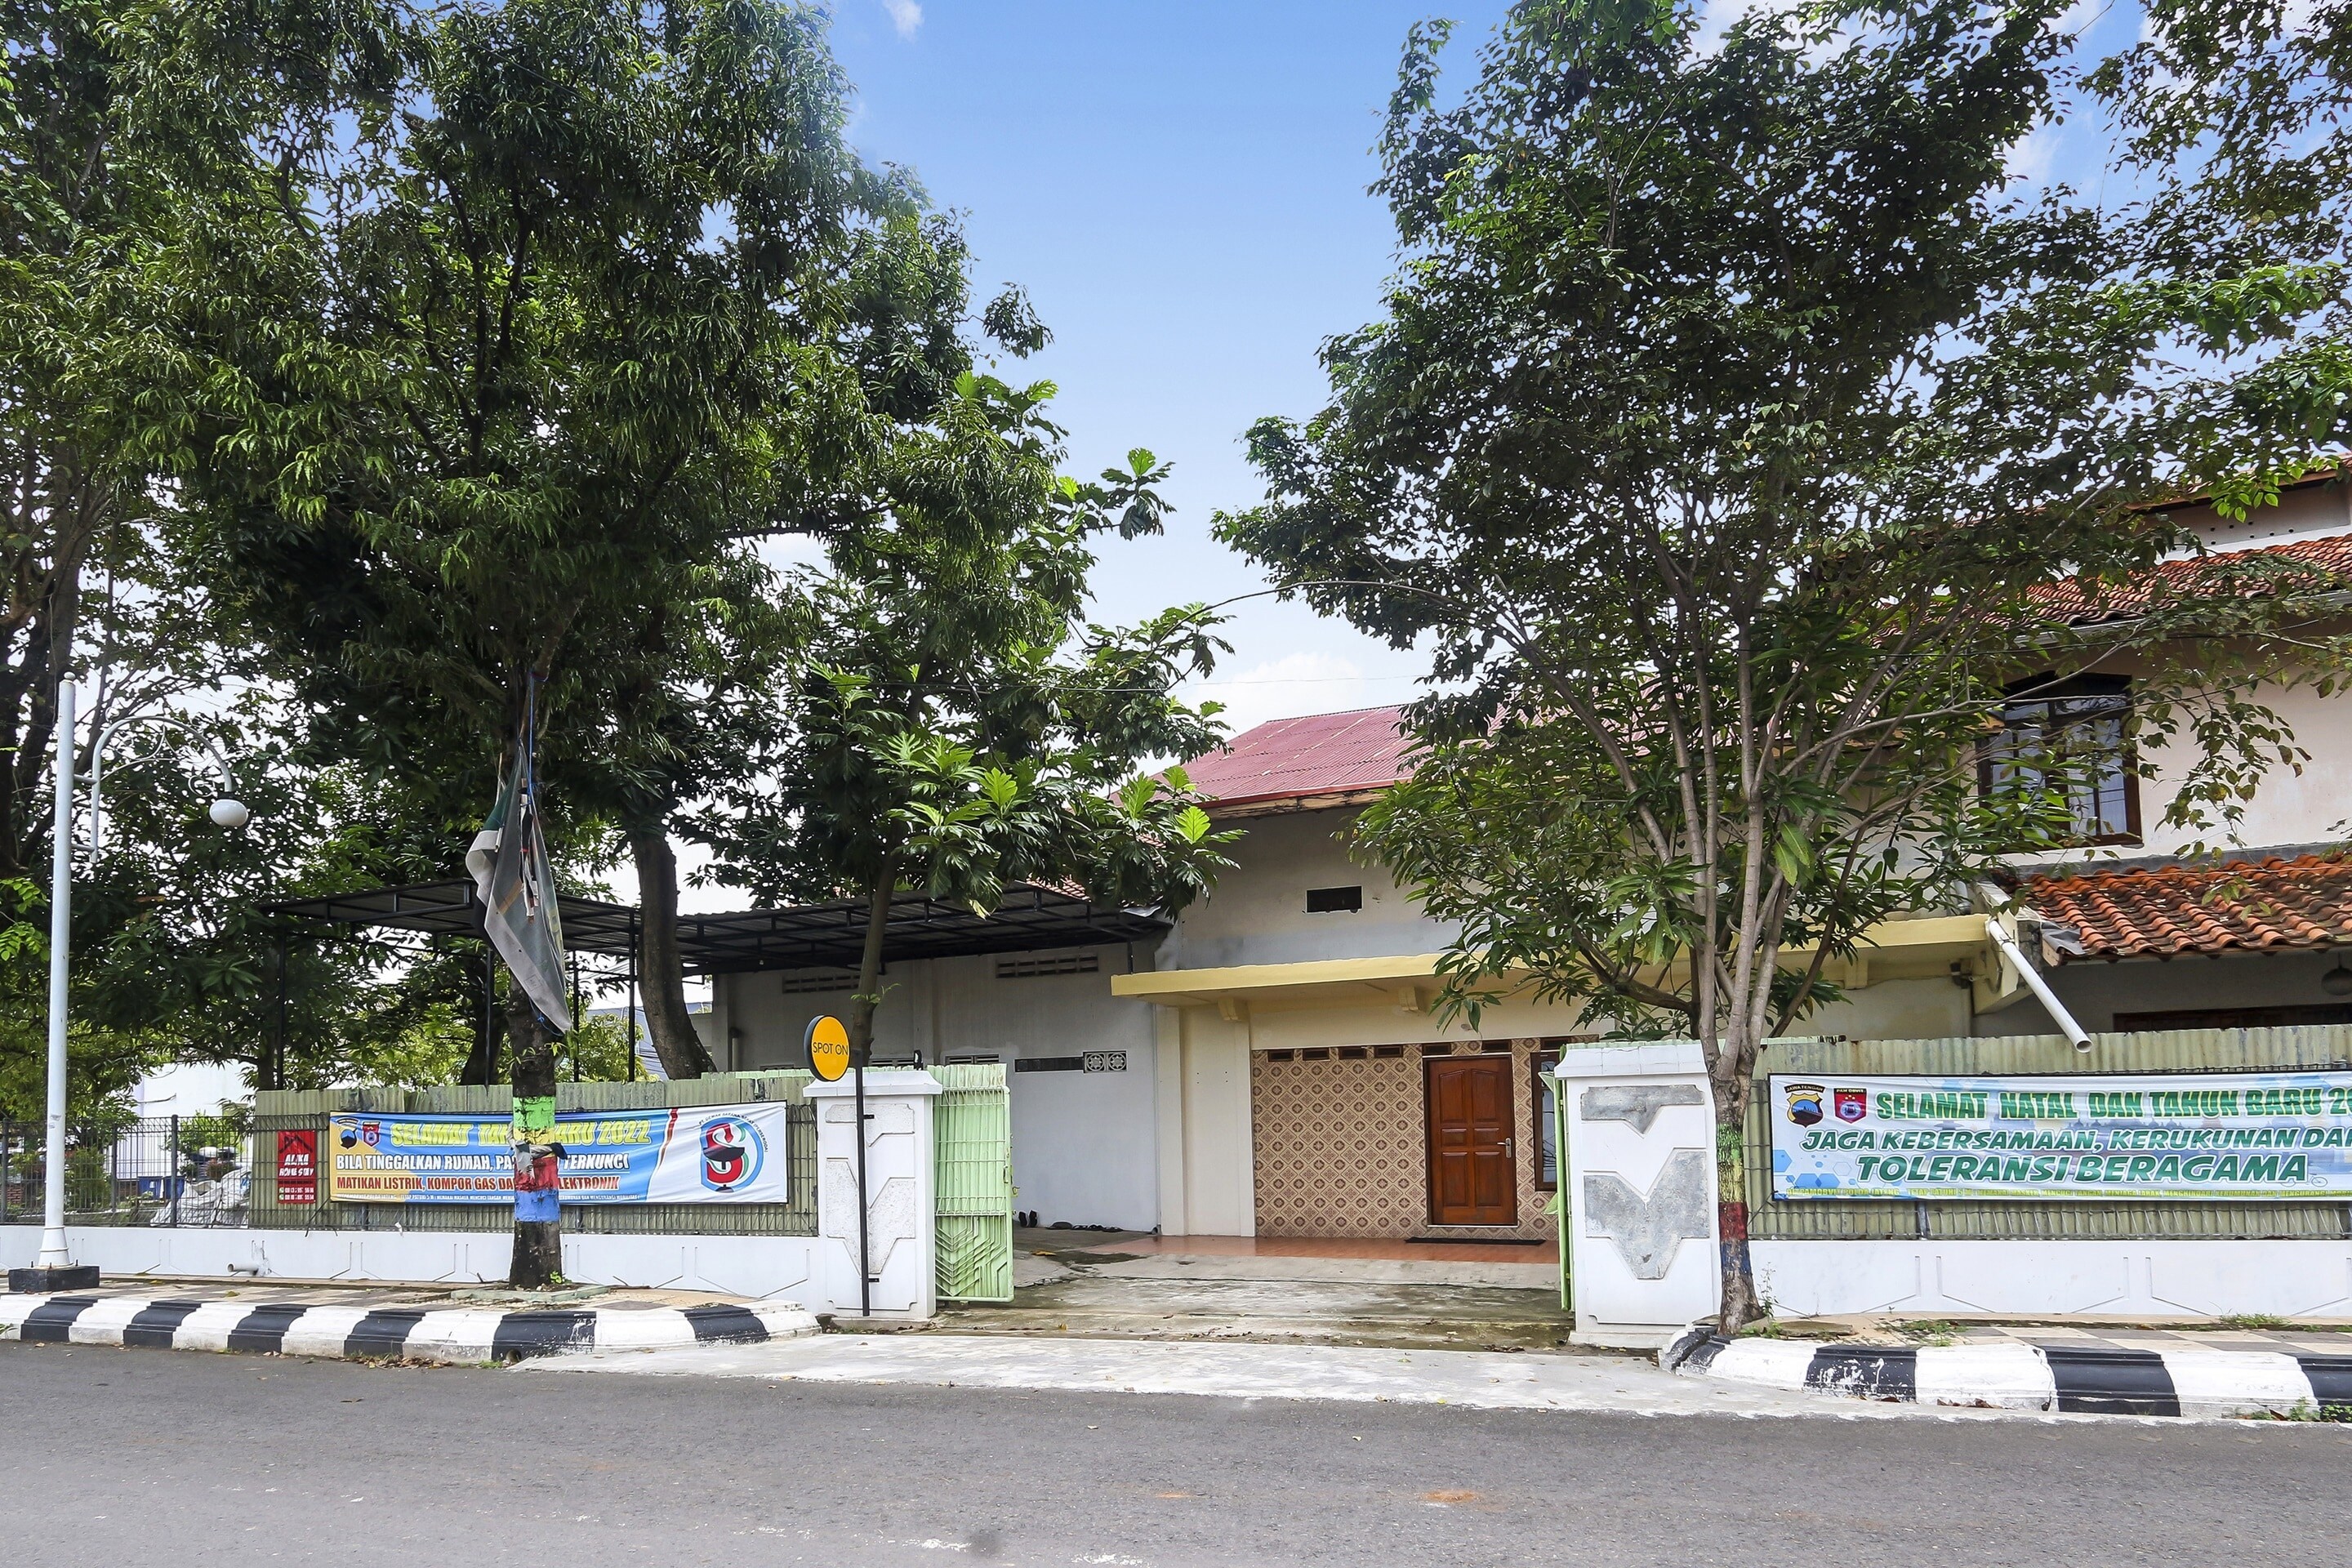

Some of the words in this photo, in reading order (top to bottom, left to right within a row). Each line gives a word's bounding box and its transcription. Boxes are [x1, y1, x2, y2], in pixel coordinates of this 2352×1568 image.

[813, 1042, 833, 1054] SPOT
[835, 1044, 849, 1055] ON
[1877, 1093, 1988, 1120] SELAMAT
[2000, 1092, 2078, 1119] NATAL
[2087, 1092, 2144, 1118] DAN
[2149, 1090, 2239, 1116] TAHUN
[2246, 1088, 2324, 1116] BARU
[392, 1124, 470, 1144] SELAMAT
[555, 1122, 595, 1144] ARU
[597, 1120, 652, 1144] 2022
[1801, 1131, 1876, 1150] JAGA
[1881, 1131, 2104, 1152] KEBERSAMAAN,
[2109, 1129, 2299, 1149] KERUKUNAN
[336, 1156, 363, 1169] BILA
[364, 1156, 441, 1169] TINGGALKAN
[445, 1156, 493, 1171] RUMAH,
[564, 1153, 629, 1169] TERKUNCI
[1857, 1156, 2069, 1181] TOLERANSI
[2075, 1154, 2308, 1183] BERAGAMA
[336, 1177, 381, 1189] MATIKAN
[384, 1177, 425, 1191] LISTRIK,
[427, 1177, 472, 1190] KOMPOR
[474, 1177, 497, 1190] GAS
[498, 1177, 514, 1190] DA
[559, 1177, 619, 1190] LEKTRONIK
